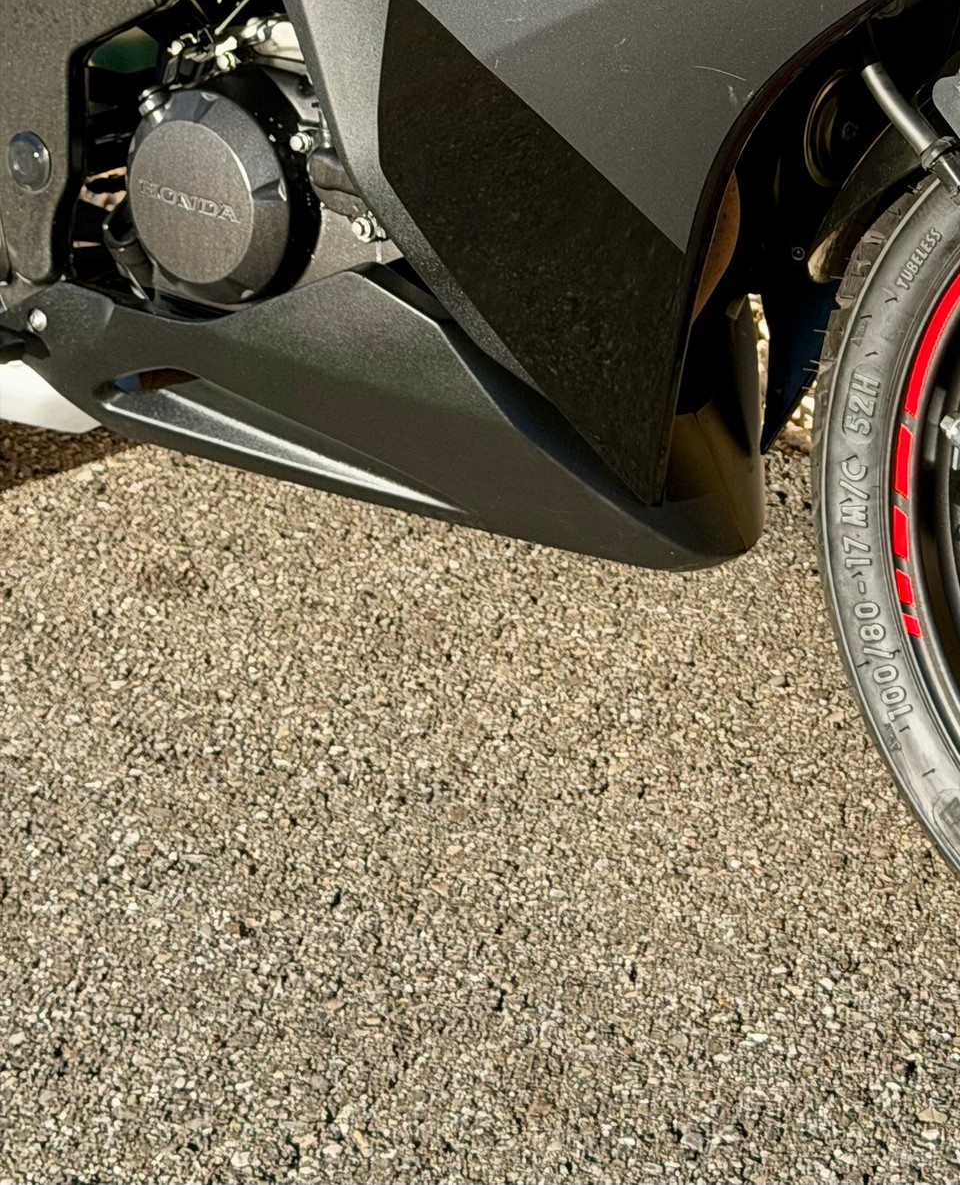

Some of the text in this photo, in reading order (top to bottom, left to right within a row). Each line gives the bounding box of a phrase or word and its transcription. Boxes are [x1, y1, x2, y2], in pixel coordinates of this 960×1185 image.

[138, 177, 241, 224] HONDA
[896, 227, 943, 291] TUBELESS
[845, 373, 881, 437] 52H
[854, 601, 914, 722] 100/80
